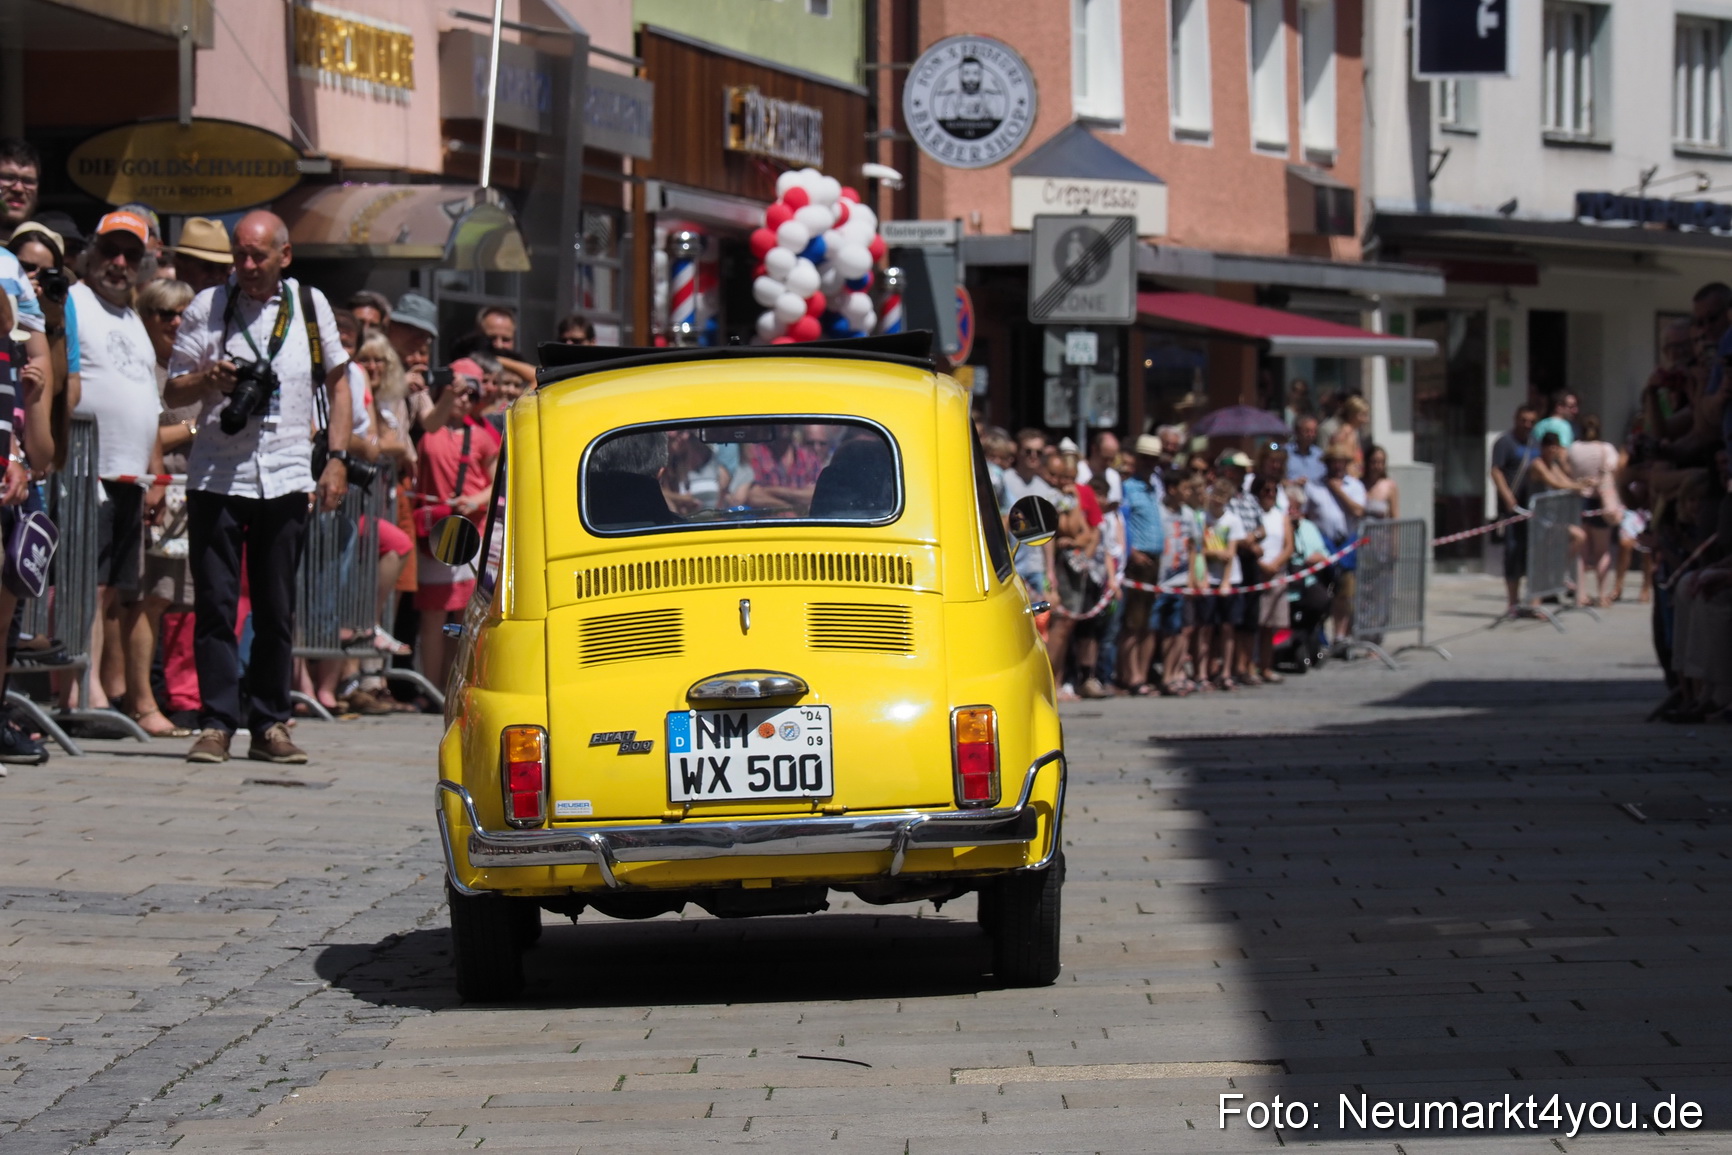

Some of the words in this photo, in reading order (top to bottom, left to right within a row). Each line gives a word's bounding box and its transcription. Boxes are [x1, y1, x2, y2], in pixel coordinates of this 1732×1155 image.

[911, 106, 1028, 162] BARBERSHOP
[78, 157, 116, 176] DIE
[120, 157, 299, 178] GOLDSCHMIEDE
[806, 710, 823, 721] 04
[592, 731, 634, 743] FIAT
[696, 712, 749, 750] NM
[621, 741, 651, 751] 500
[675, 736, 685, 748] D
[807, 735, 824, 747] 09
[680, 755, 732, 795] WX
[748, 753, 823, 792] 500
